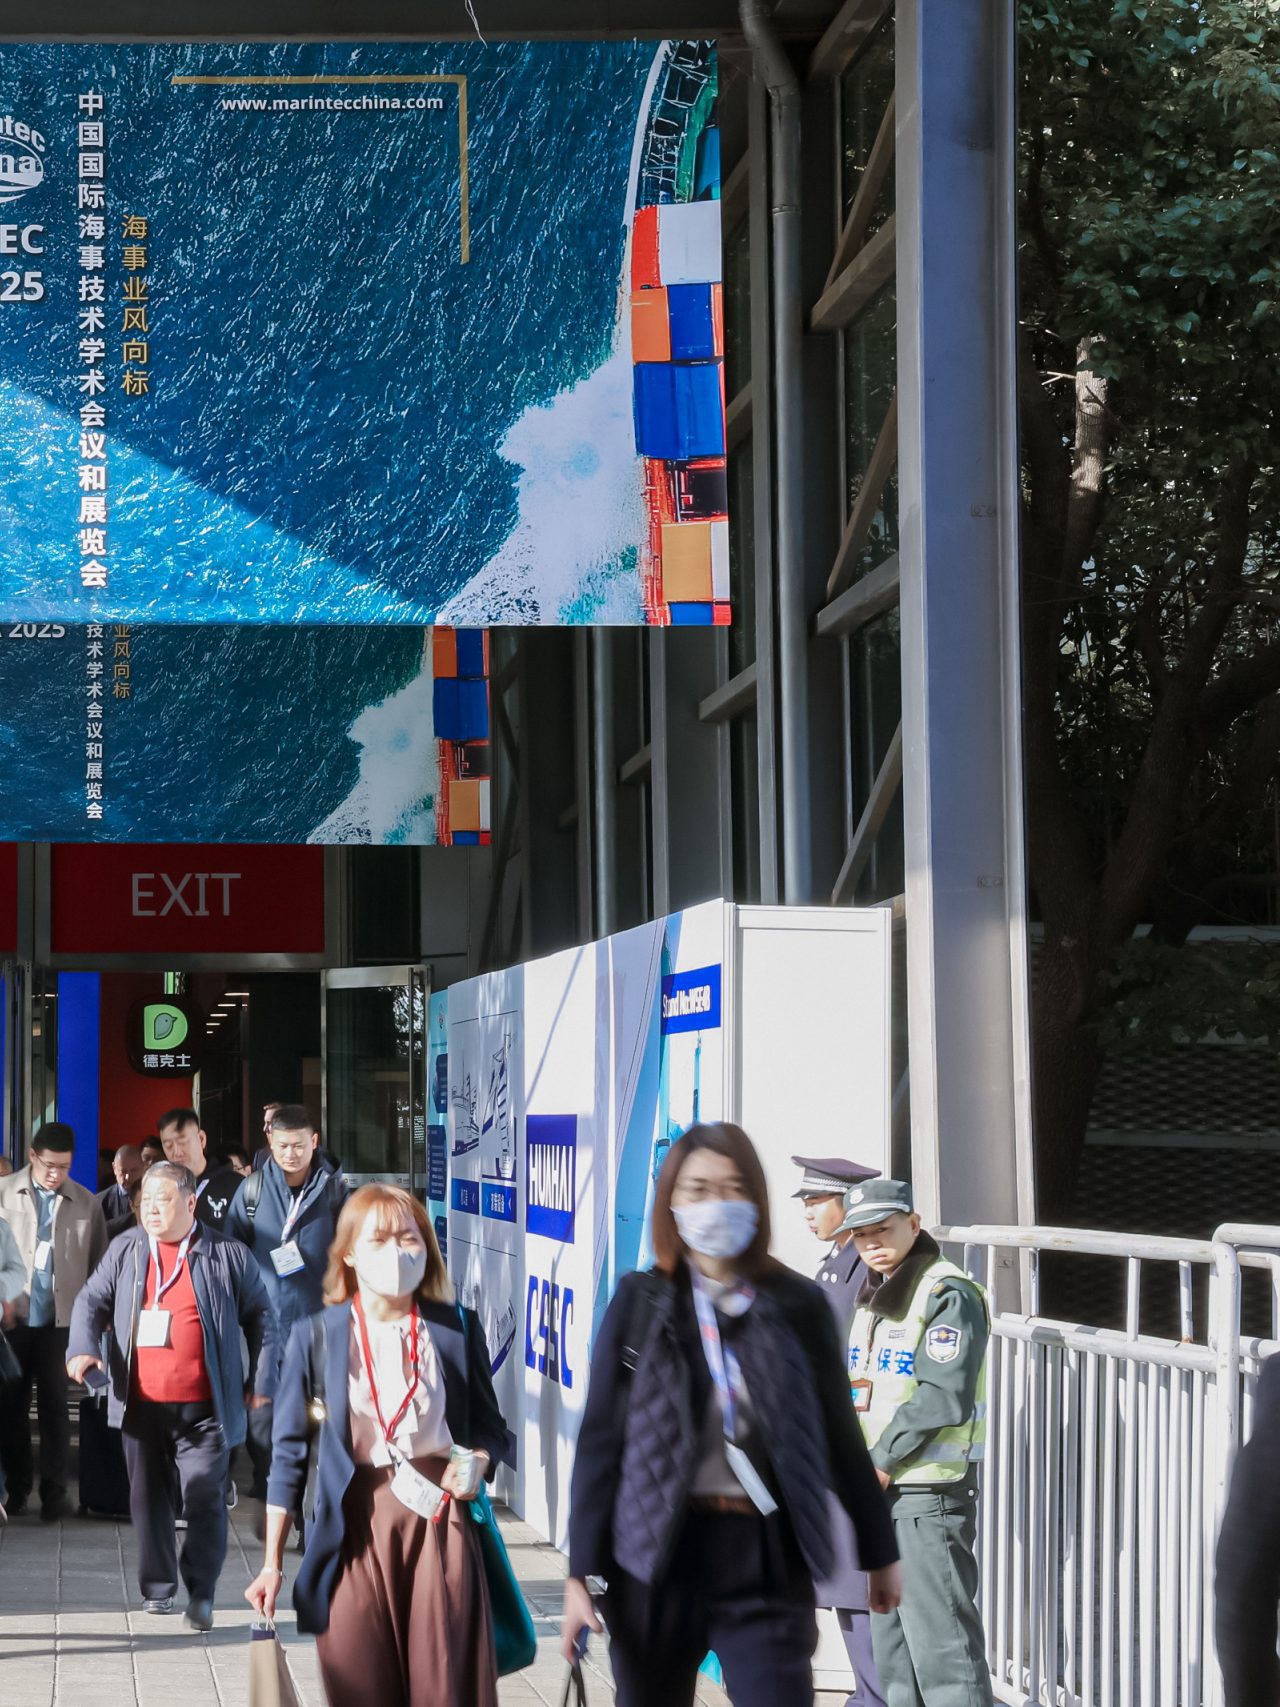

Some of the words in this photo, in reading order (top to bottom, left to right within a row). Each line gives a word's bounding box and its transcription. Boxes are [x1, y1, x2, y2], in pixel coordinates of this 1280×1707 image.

[221, 95, 444, 111] www.marintecchina.com
[121, 213, 149, 396] 海事业风向标
[78, 92, 107, 588] 中国国际海事技术学术会议和展览会
[8, 624, 65, 638] 2025
[131, 872, 242, 917] EXIT
[143, 1053, 191, 1068] 德克士
[529, 1144, 573, 1213] HUAHAI
[526, 1274, 574, 1389] CSSC
[877, 1347, 914, 1376] 保安
